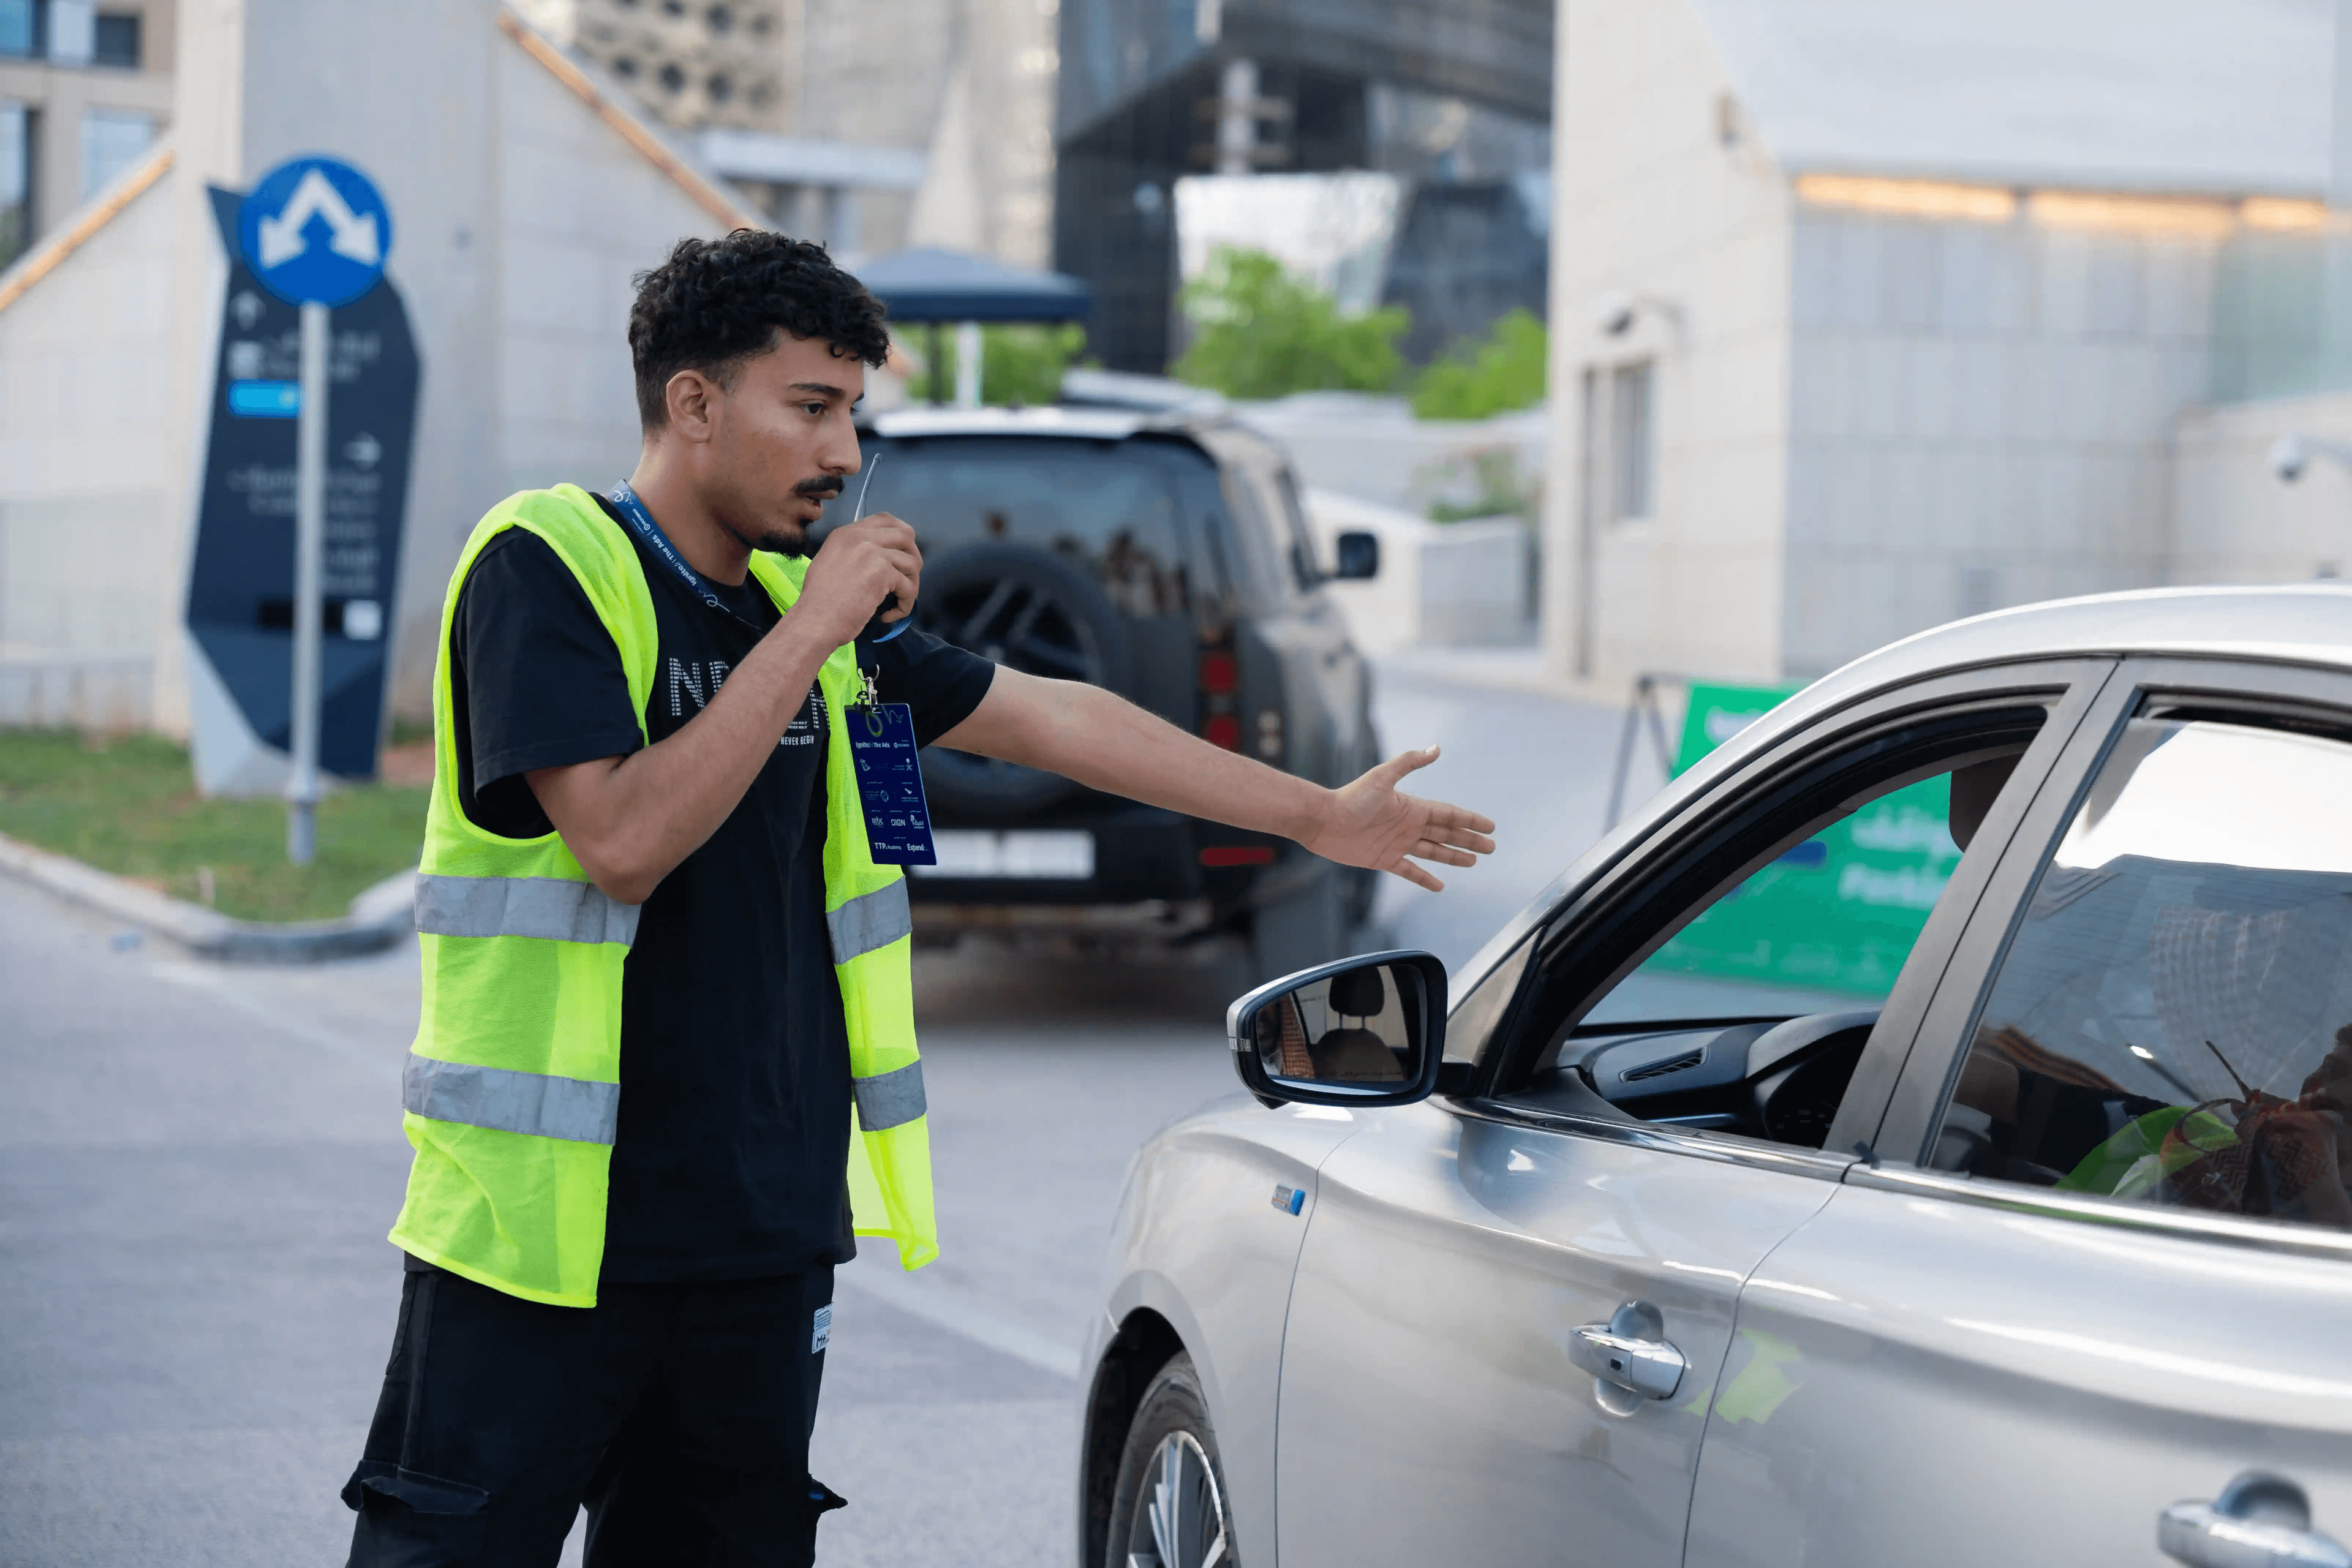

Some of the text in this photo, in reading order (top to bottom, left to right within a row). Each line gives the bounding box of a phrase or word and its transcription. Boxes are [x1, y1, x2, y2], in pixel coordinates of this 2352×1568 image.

[652, 534, 697, 586] Ignite The Ads
[780, 736, 799, 745] NEVER
